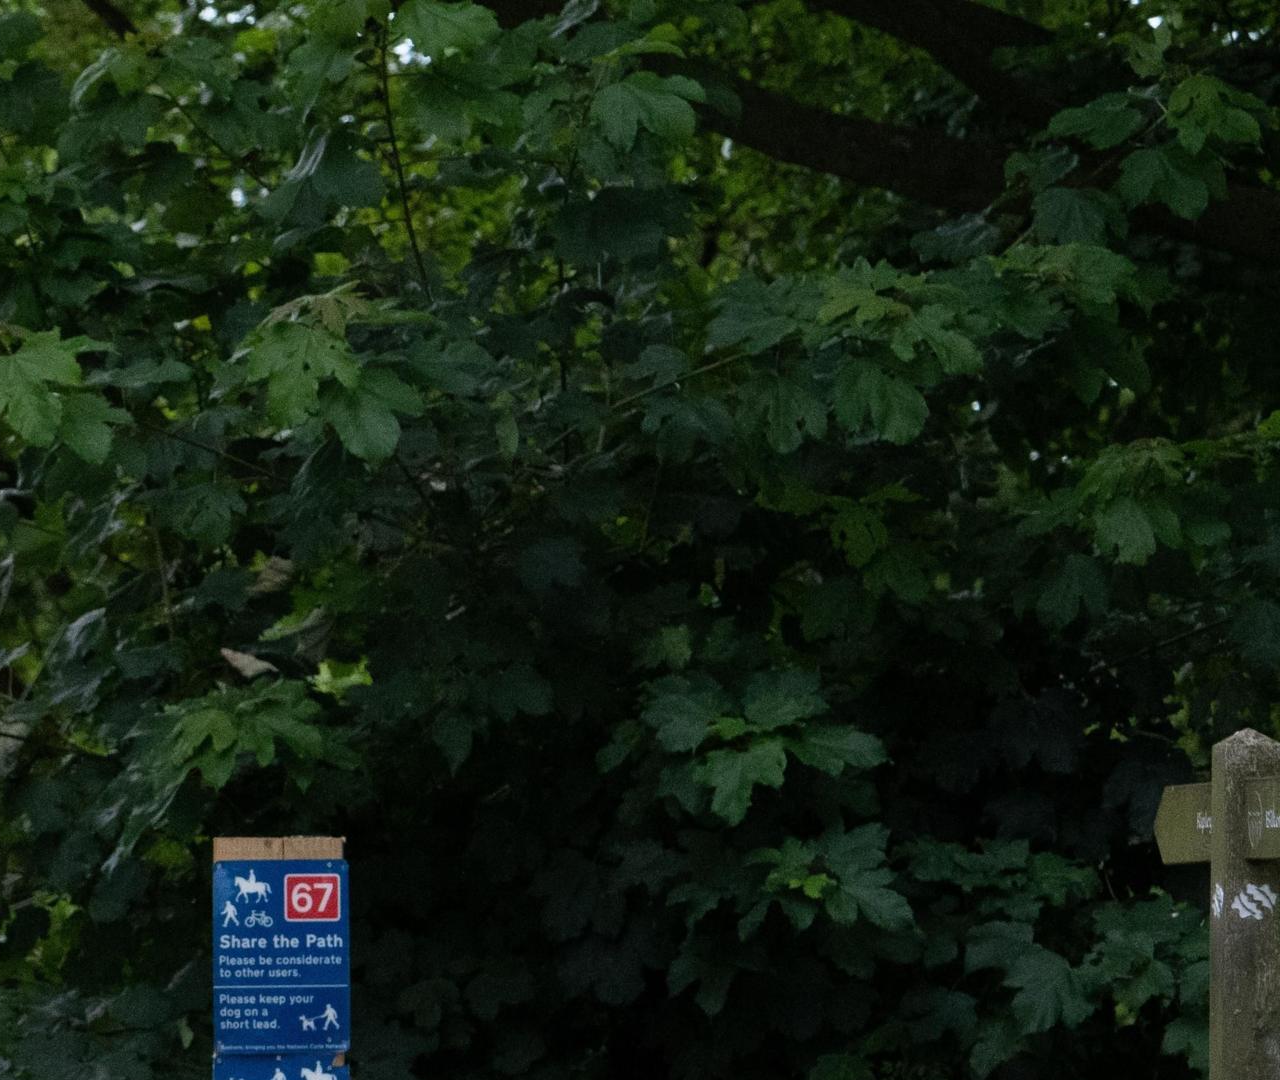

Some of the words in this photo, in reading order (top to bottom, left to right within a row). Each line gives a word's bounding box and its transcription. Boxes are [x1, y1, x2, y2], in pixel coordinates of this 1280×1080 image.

[291, 882, 334, 913] 67
[220, 934, 267, 949] Share
[272, 934, 300, 949] the
[306, 934, 343, 948] Path
[219, 955, 255, 966] Please
[259, 955, 273, 966] be
[276, 954, 342, 965] considerate
[220, 968, 232, 978] to
[235, 968, 264, 978] other
[269, 968, 301, 978] users.
[219, 994, 256, 1004] Please
[259, 994, 286, 1007] keep
[289, 995, 314, 1006] your
[220, 1007, 241, 1018] dog
[244, 1008, 258, 1017] on
[261, 1008, 269, 1017] a
[220, 1019, 249, 1029] short
[253, 1019, 280, 1029] lead.
